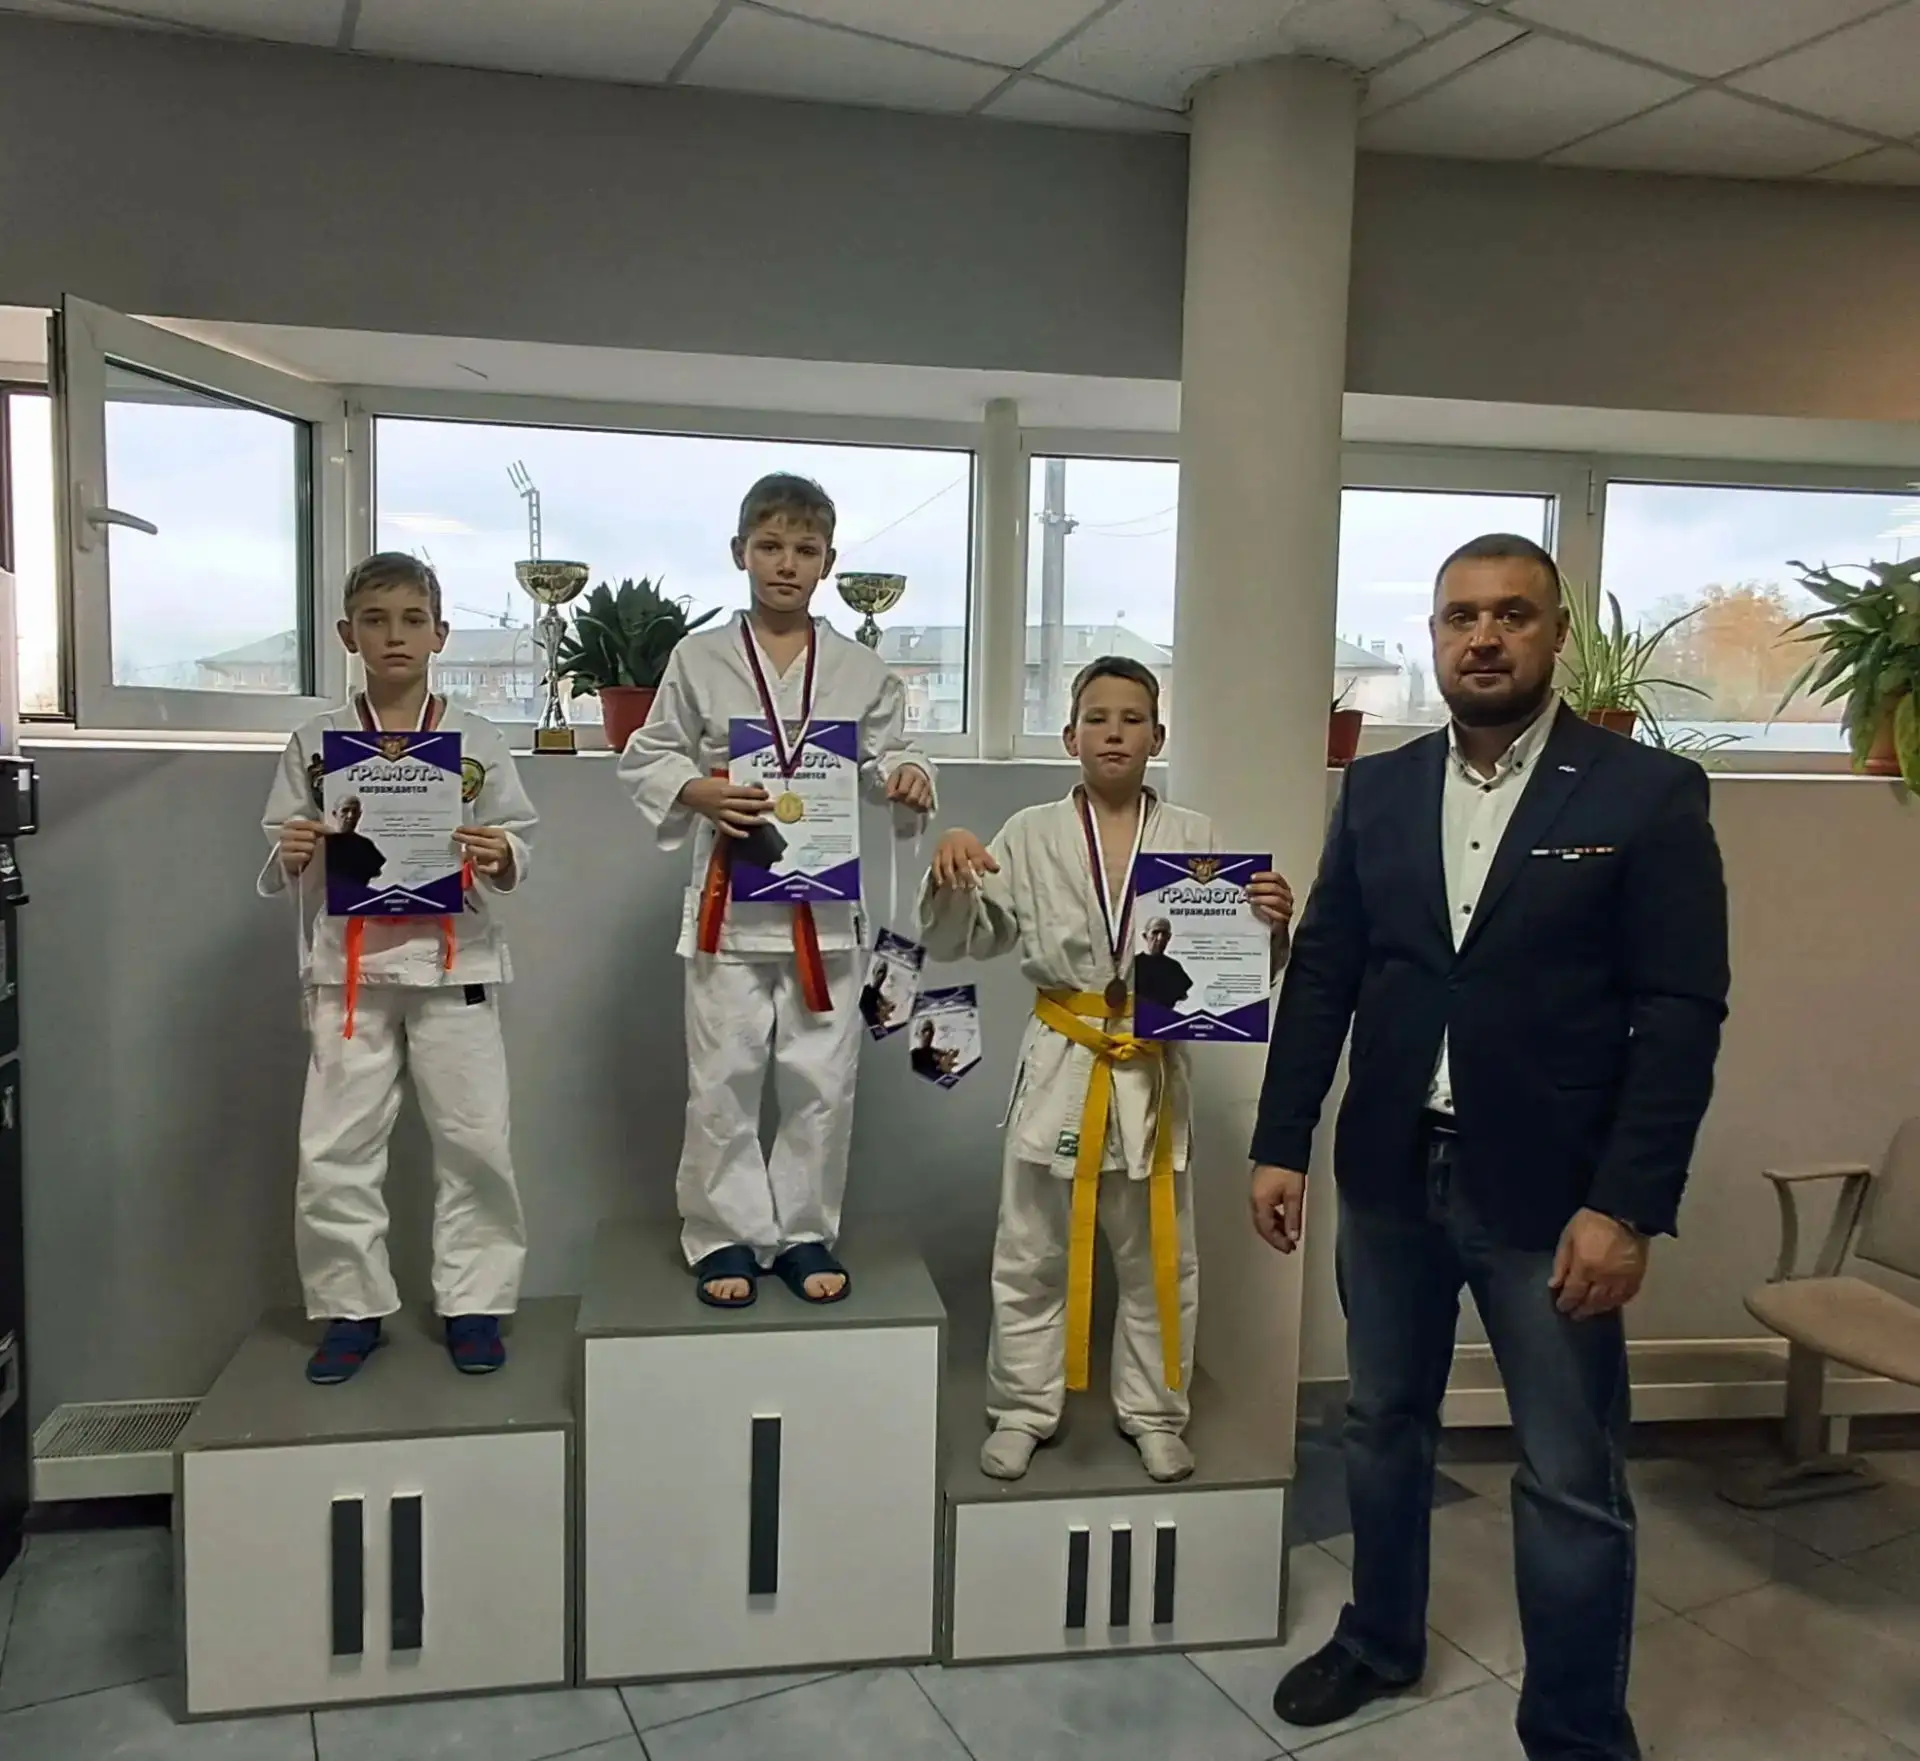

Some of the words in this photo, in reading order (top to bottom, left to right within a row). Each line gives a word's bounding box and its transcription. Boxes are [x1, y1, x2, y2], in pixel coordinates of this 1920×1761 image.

[751, 752, 842, 769] ГРОТА
[347, 765, 444, 781] ГРАМОТА
[762, 772, 826, 780] нагрдается
[358, 785, 428, 795] награждается
[1169, 908, 1237, 918] награждается
